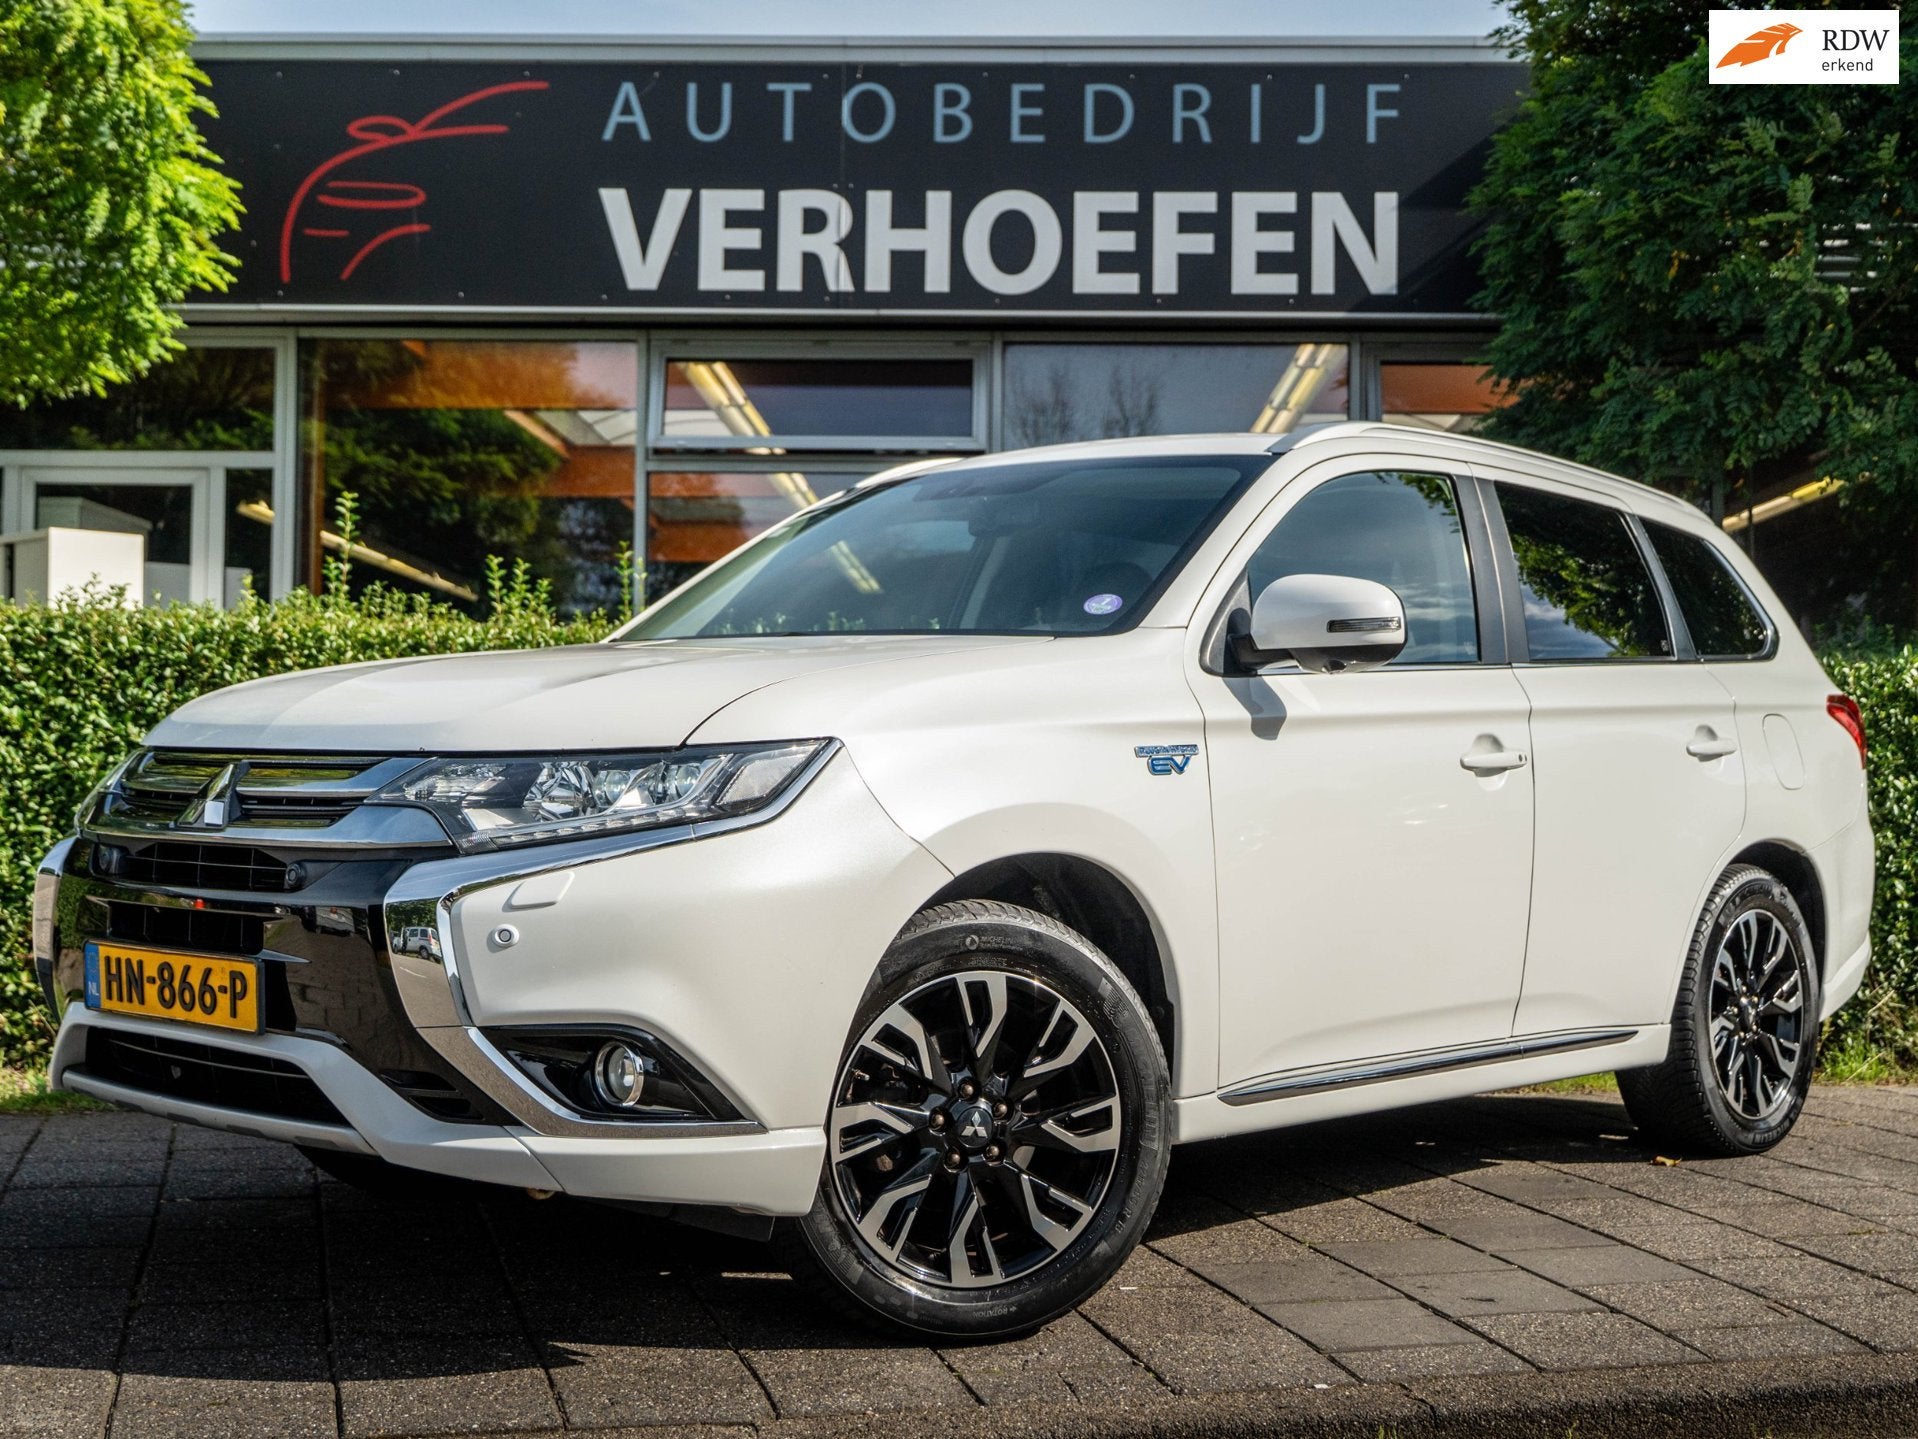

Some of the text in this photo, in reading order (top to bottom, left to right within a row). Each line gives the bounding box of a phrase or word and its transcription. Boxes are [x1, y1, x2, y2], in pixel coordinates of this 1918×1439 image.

[601, 81, 1401, 145] AUTOBEDRIJF
[598, 187, 1399, 296] VERHOEFEN
[1147, 755, 1192, 776] EV
[88, 981, 100, 996] NL
[104, 955, 248, 1019] HN-866-P
